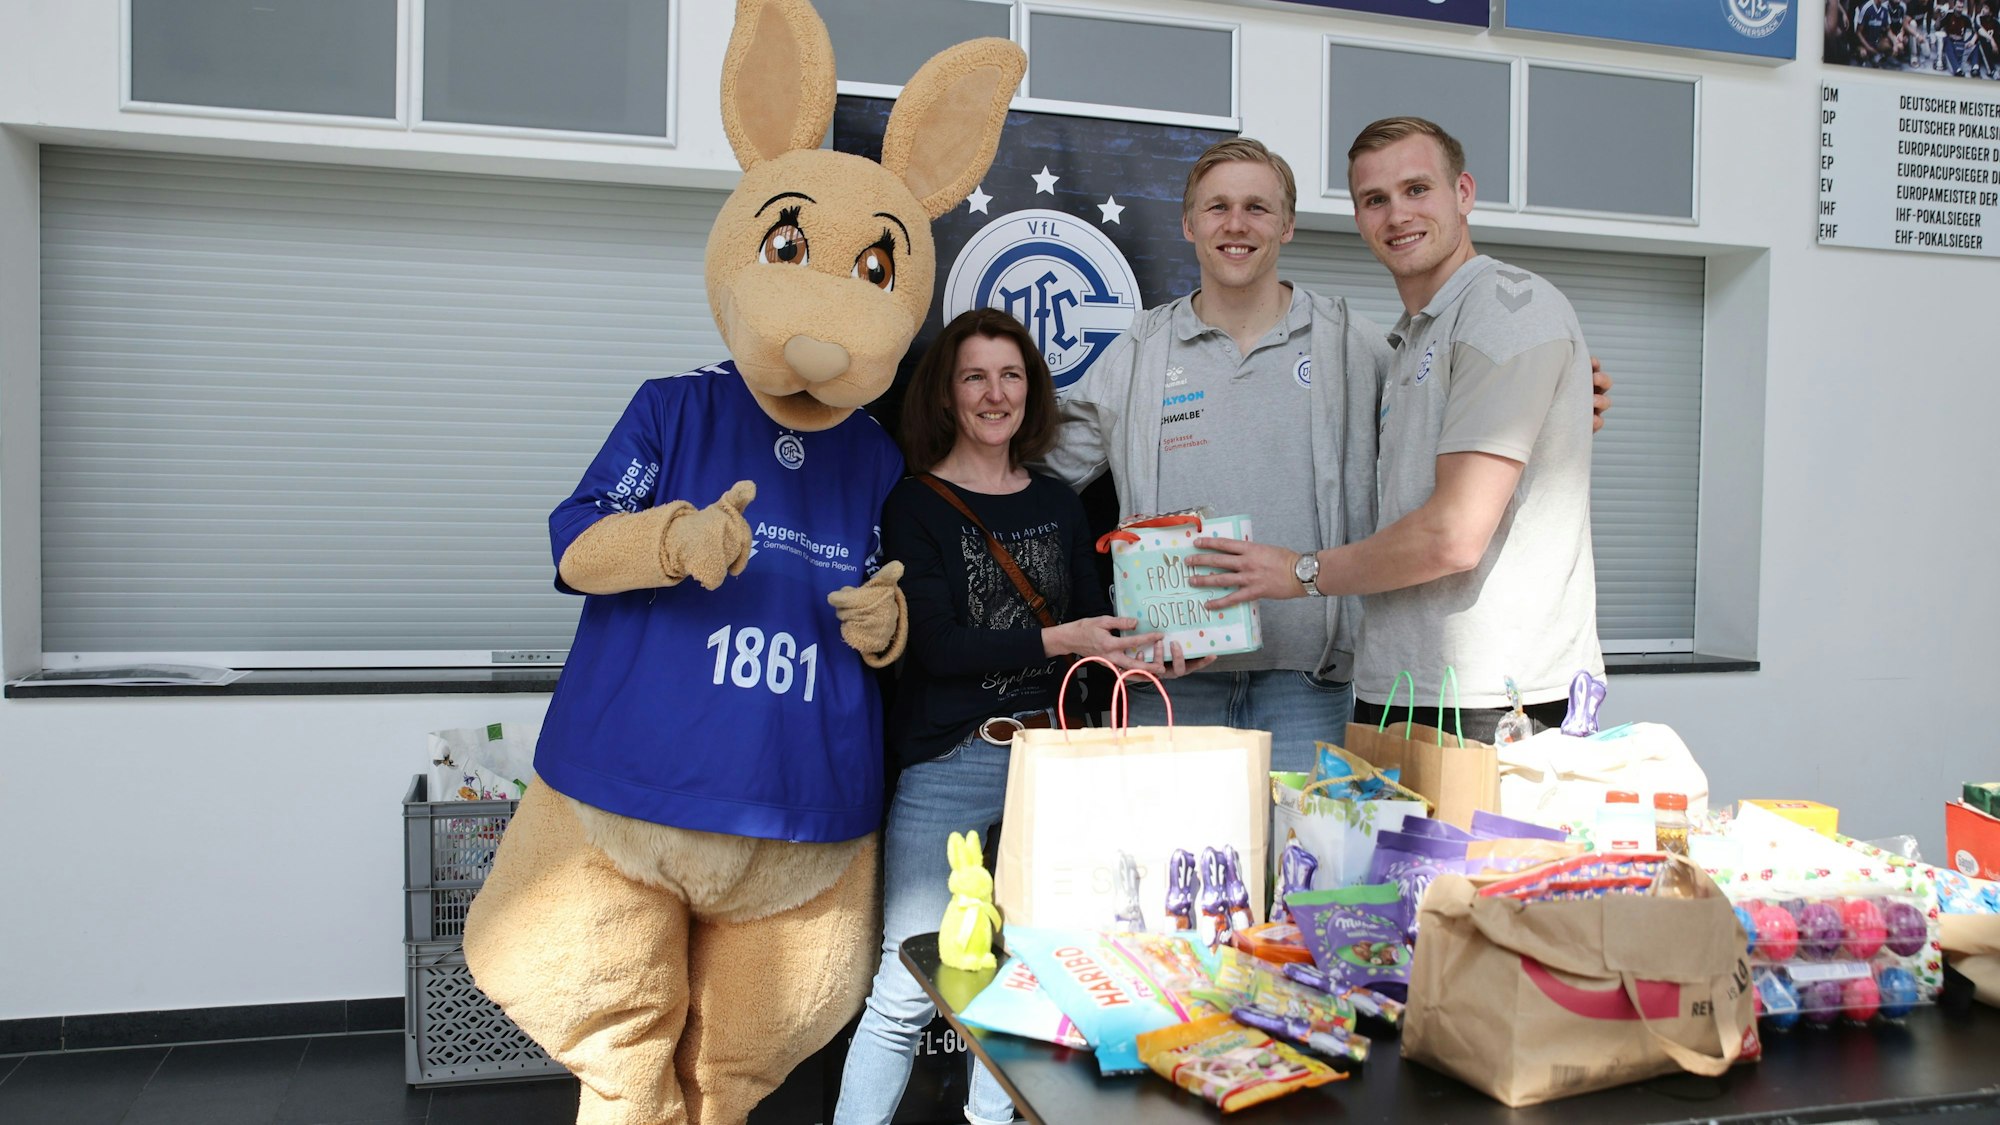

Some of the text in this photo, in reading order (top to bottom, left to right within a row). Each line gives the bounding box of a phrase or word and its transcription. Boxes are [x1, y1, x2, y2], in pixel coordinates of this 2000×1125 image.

[1823, 87, 1838, 102] DM
[1900, 95, 1956, 115] DEUTSCHER
[1822, 110, 1836, 125] DP
[1822, 132, 1833, 147] EL
[1899, 118, 2000, 141] DEUTSCHER POKALSI
[1898, 140, 1990, 162] EUROPACUPSIEGER
[1821, 155, 1834, 170] EP
[1897, 162, 1989, 184] EUROPACUPSIEGER
[1821, 178, 1833, 193] EV
[1896, 185, 1998, 207] EUROPAMEISTER DER
[1820, 200, 1836, 216] IHF
[1896, 207, 1981, 228] IHF-POKALSIEGER
[1027, 221, 1060, 238] VfL
[1819, 223, 1838, 239] EHF
[1895, 229, 1983, 250] EHF-POKALSIEGER
[1165, 377, 1188, 389] ummel
[1163, 390, 1205, 407] LYGON
[1163, 433, 1193, 446] Sparkasse
[1163, 439, 1209, 453] Gummersbach
[607, 458, 643, 502] Agger
[622, 462, 660, 513] Energie
[755, 522, 849, 559] AggerEnergie
[992, 531, 1004, 541] IT
[1011, 521, 1059, 541] HAPPEN
[763, 541, 803, 556] Gemeinsam
[831, 560, 857, 573] Region
[1147, 598, 1212, 629] OSTERN
[707, 624, 818, 702] 1861
[1055, 947, 1131, 1007] HARIBO
